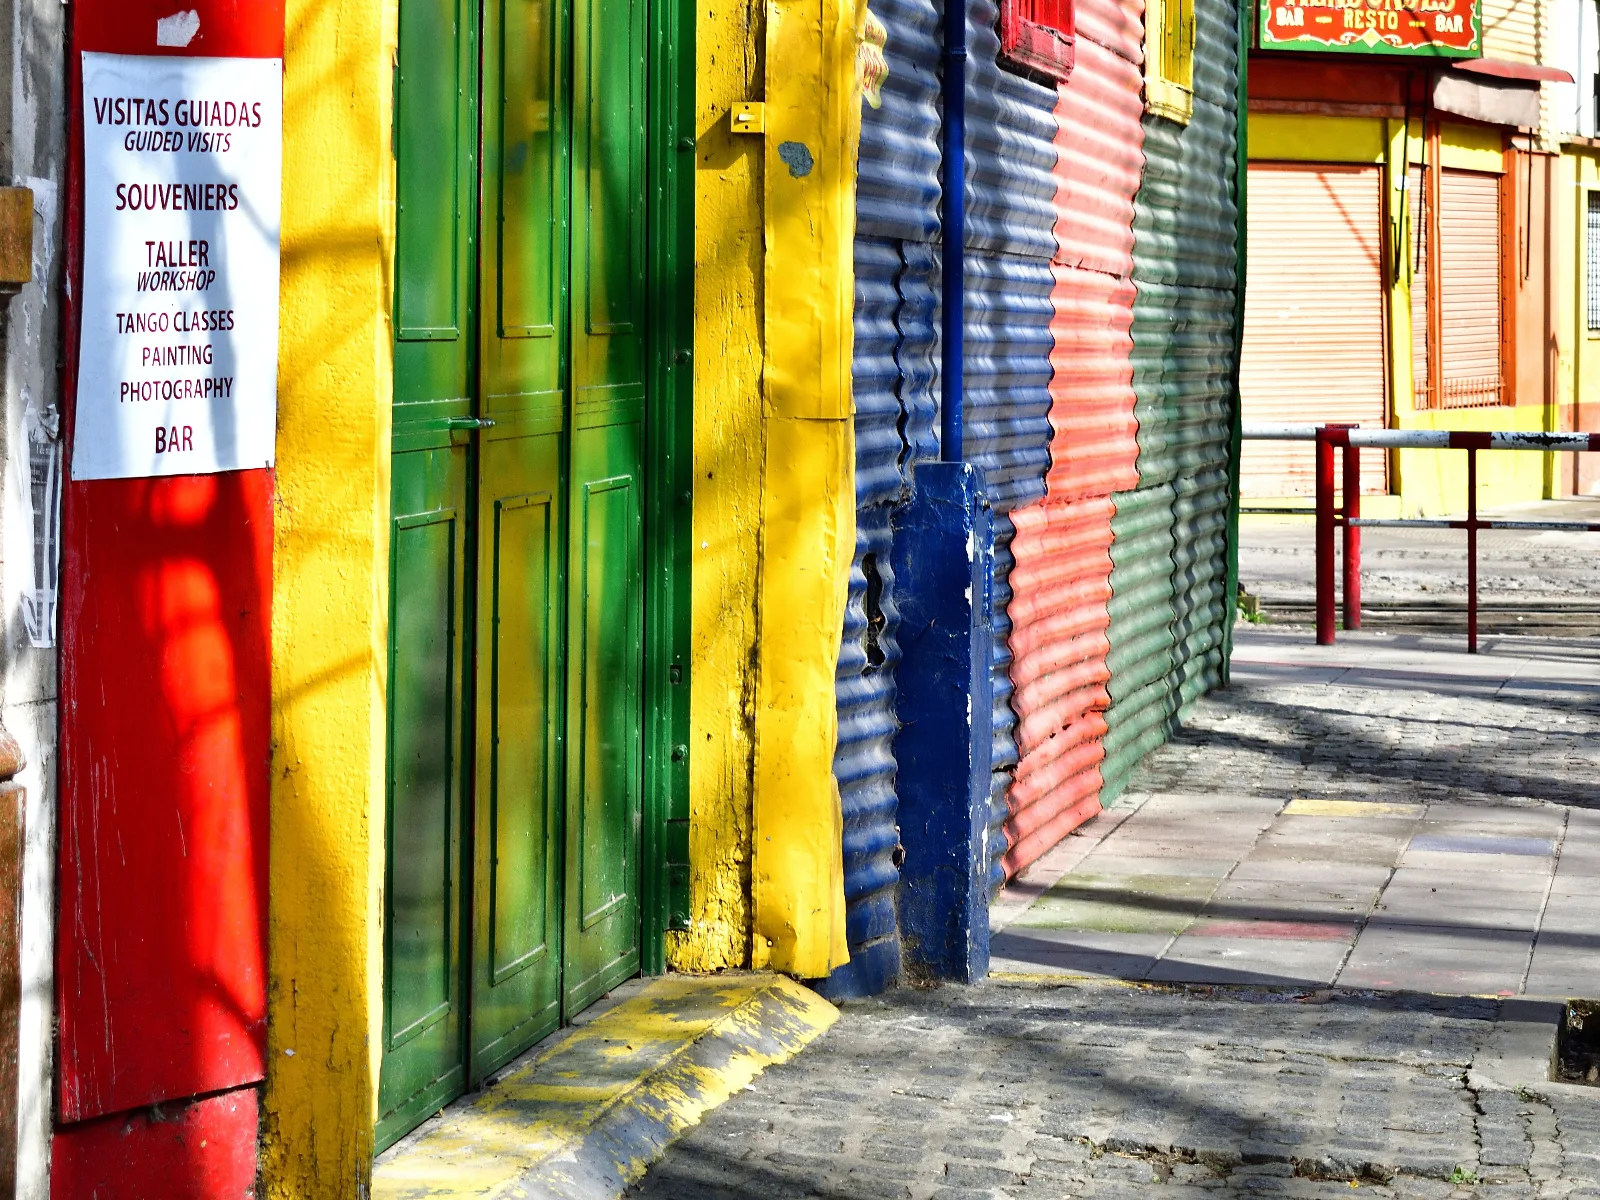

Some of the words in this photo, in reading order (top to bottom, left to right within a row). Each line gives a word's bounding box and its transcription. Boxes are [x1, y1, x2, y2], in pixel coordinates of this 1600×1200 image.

[1276, 7, 1304, 26] BAR
[1344, 9, 1398, 30] RESTO
[1435, 14, 1463, 33] BAR
[94, 97, 169, 126] VISITAS
[175, 99, 262, 128] GUIADAS
[124, 131, 183, 152] GUIDED
[188, 132, 232, 153] VISITS
[116, 183, 238, 211] SOUVENIERS
[145, 240, 209, 268] TALLER
[137, 270, 216, 292] WORKSHOP
[116, 312, 169, 334] TANGO
[173, 310, 234, 332] CLASSES
[142, 344, 212, 367] PAINTING
[120, 377, 234, 403] PHOTOGRAPHY
[155, 425, 193, 453] BAR
